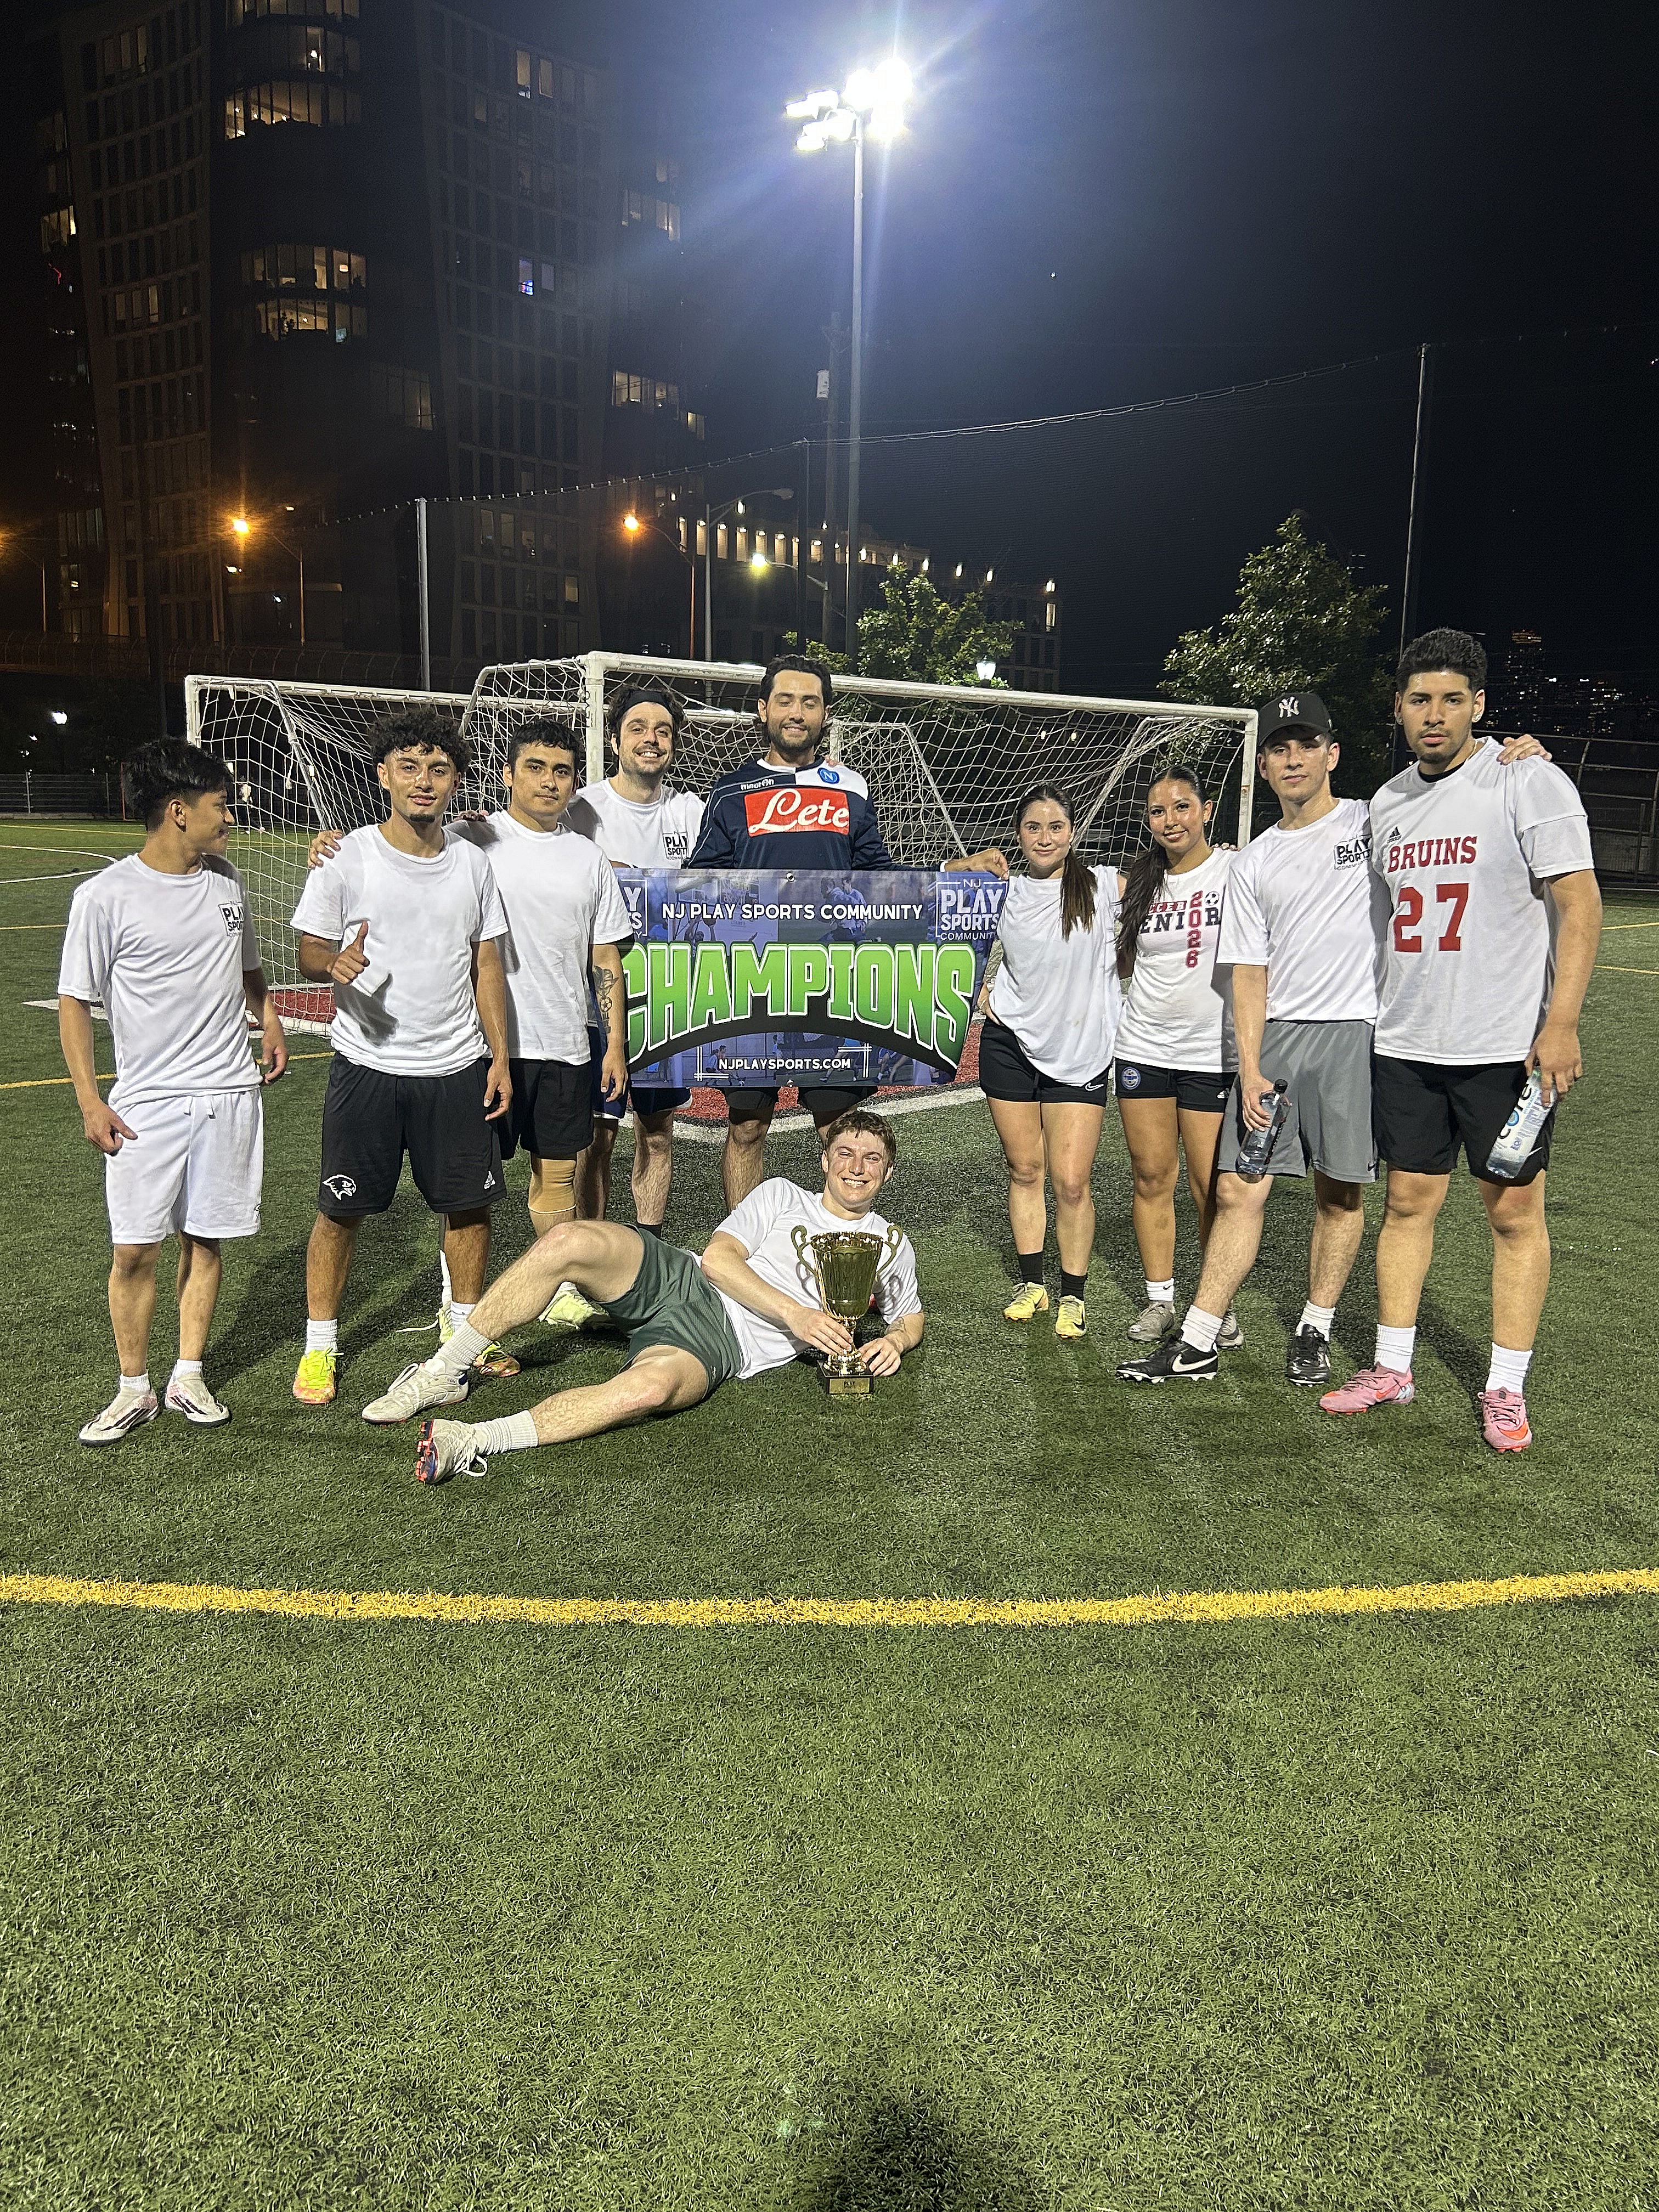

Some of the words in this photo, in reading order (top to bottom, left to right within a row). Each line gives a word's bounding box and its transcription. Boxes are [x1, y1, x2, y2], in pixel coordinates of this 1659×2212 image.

[1278, 696, 1300, 718] NY
[748, 788, 849, 833] Lete
[1336, 838, 1370, 858] PLAY
[1387, 836, 1477, 873] BRUINS
[963, 878, 981, 888] NJ
[662, 903, 685, 919] NJ
[690, 904, 736, 919] PLAY
[741, 904, 815, 919] SPORTS
[820, 904, 923, 920] COMMUNITY
[941, 889, 1003, 914] PLAY
[940, 914, 999, 930] SPORTS
[1393, 883, 1469, 953] 27
[940, 932, 994, 940] COMMUNIT
[622, 942, 976, 1069] CHAMPIONS
[719, 1058, 850, 1070] NJPLAYSPORTS.COM
